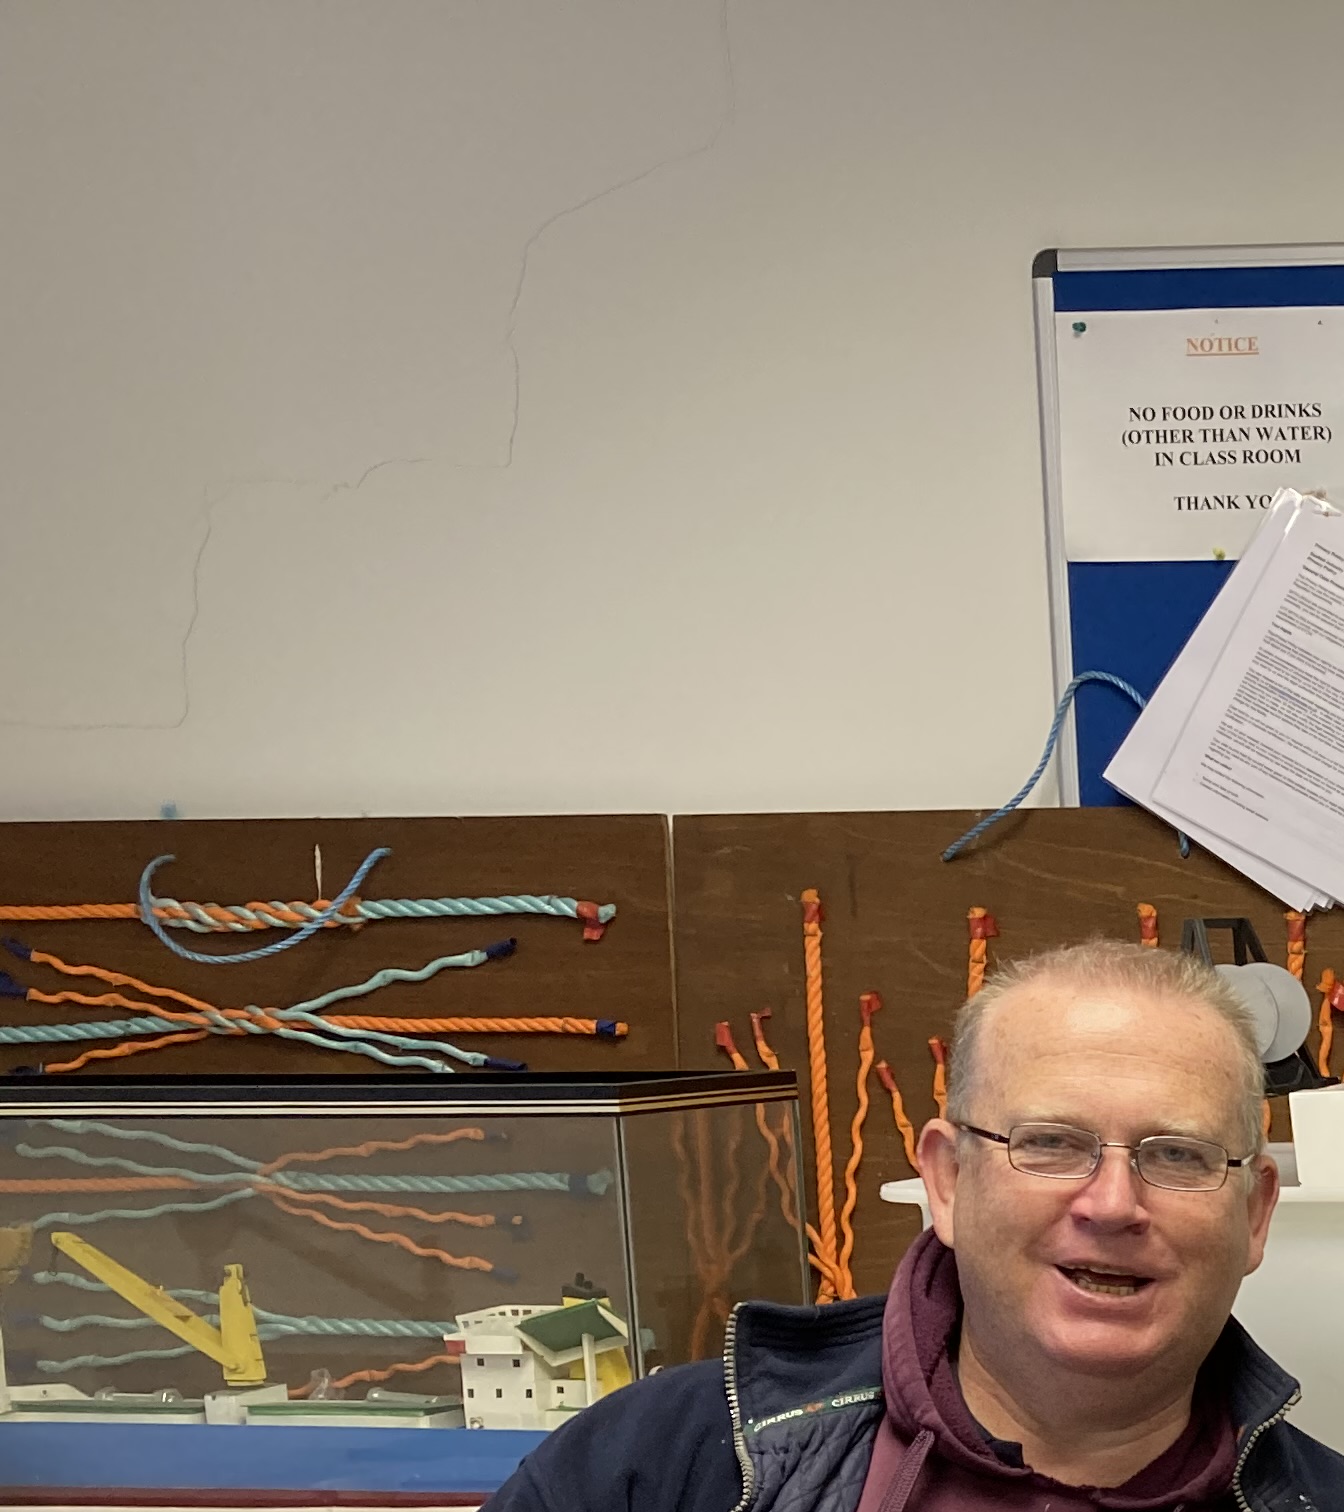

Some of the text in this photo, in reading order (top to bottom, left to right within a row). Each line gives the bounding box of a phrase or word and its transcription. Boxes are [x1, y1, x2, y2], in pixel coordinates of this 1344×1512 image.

[1186, 337, 1259, 355] NOTICE
[1129, 403, 1322, 422] NO FOOD OR DRINKS
[1122, 426, 1332, 446] (OTHER THAN WATER)
[1155, 449, 1301, 466] IN CLASS ROOM
[1174, 495, 1240, 510] THANK
[832, 1392, 874, 1407] CIRRUS
[754, 1409, 803, 1432] CIRRUS
